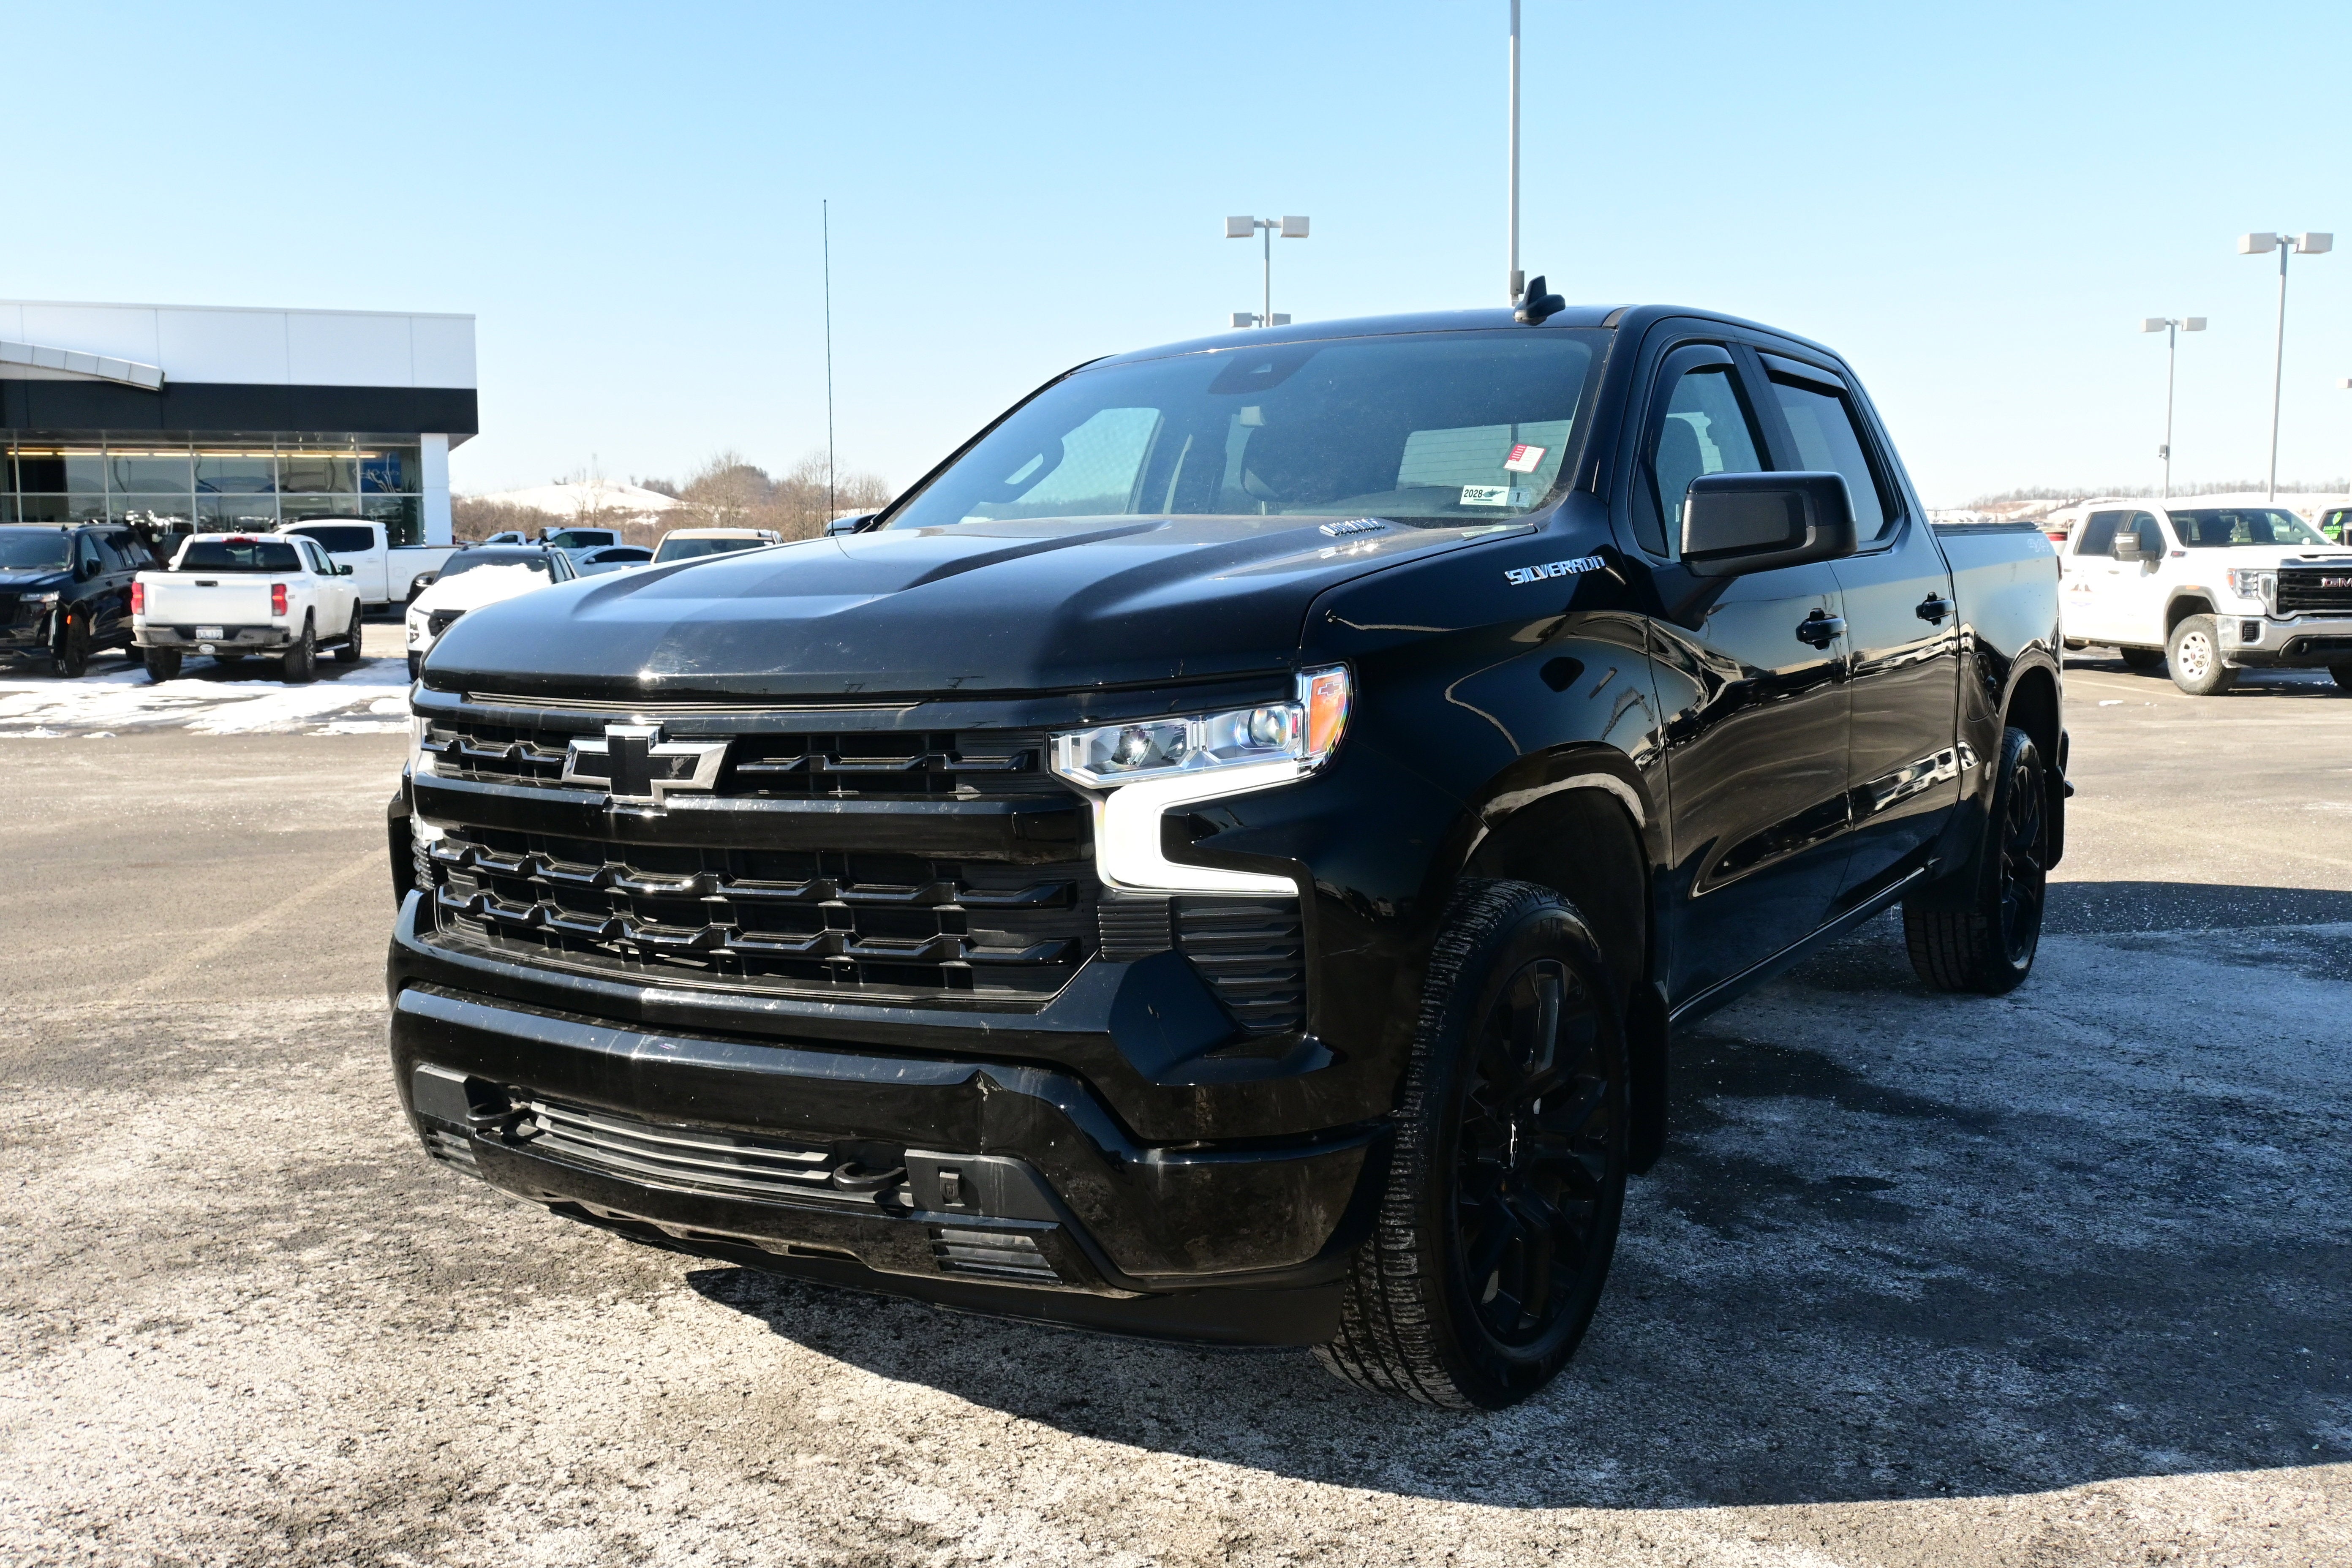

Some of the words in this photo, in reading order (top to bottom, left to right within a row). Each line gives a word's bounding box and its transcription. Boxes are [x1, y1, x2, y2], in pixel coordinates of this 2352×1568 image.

[1464, 489, 1483, 498] 2028
[1516, 492, 1521, 502] 1
[1504, 555, 1606, 585] SILVERADO
